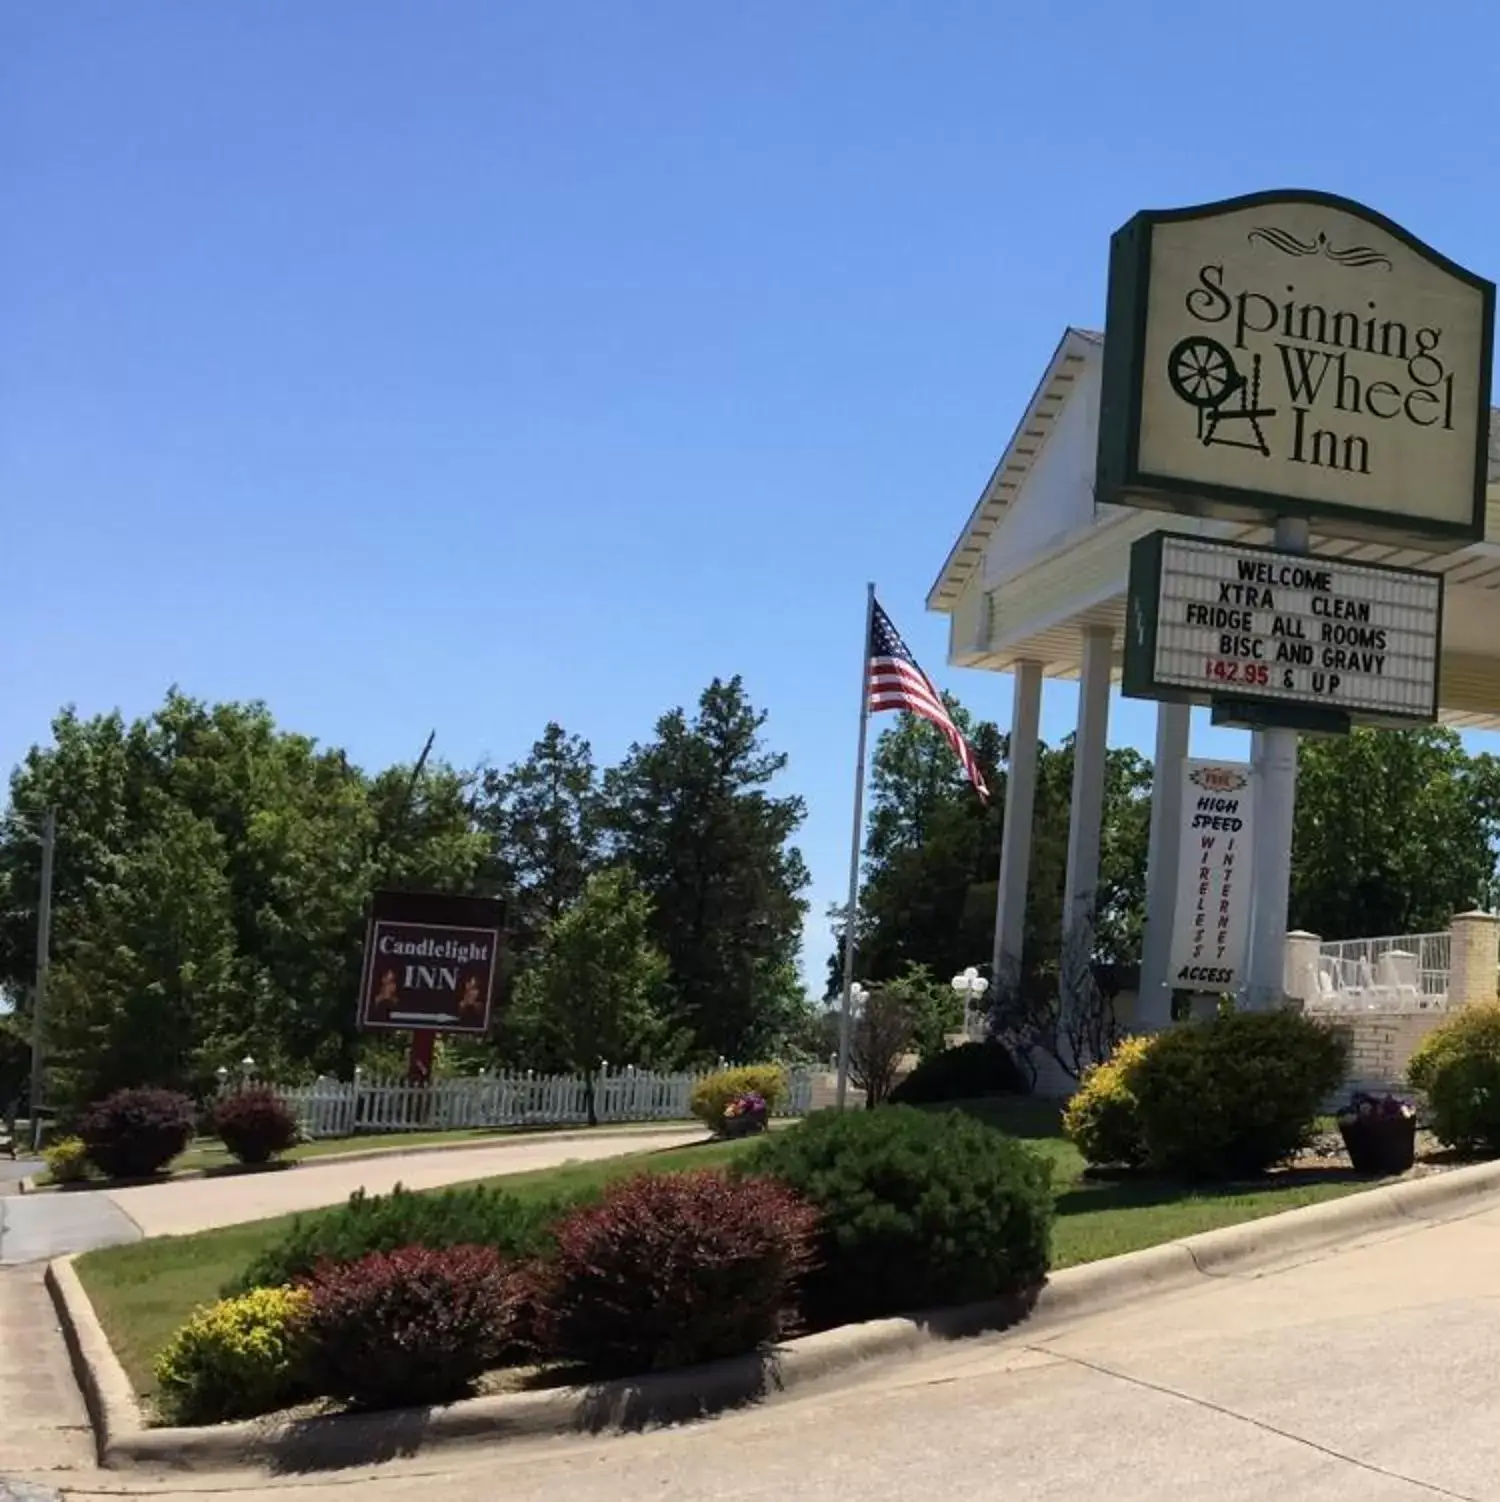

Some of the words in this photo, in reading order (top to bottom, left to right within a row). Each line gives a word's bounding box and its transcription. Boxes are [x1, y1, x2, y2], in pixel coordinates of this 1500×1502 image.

[1185, 264, 1444, 386] Spinning
[1274, 343, 1455, 430] Wheel
[1288, 406, 1372, 474] Inn
[1237, 559, 1333, 592] WELCOME
[1219, 582, 1274, 609] XTRA
[1311, 596, 1370, 623] CLEAN
[1186, 604, 1253, 632] FRIDGE
[1271, 617, 1306, 638] ALL
[1321, 623, 1386, 650] ROOMS
[1219, 635, 1263, 659] BISC
[1276, 642, 1313, 665] AND
[1322, 649, 1386, 675] GRAVY
[1283, 668, 1295, 688] &
[1312, 671, 1340, 695] UP
[1191, 814, 1243, 833] SPEED
[1197, 797, 1239, 814] HIGH
[1193, 835, 1216, 959] WIRELESS
[1216, 837, 1234, 960] INTERNET
[379, 935, 488, 963] Candlelight
[403, 965, 460, 991] INN
[1177, 966, 1234, 984] ACCESS
